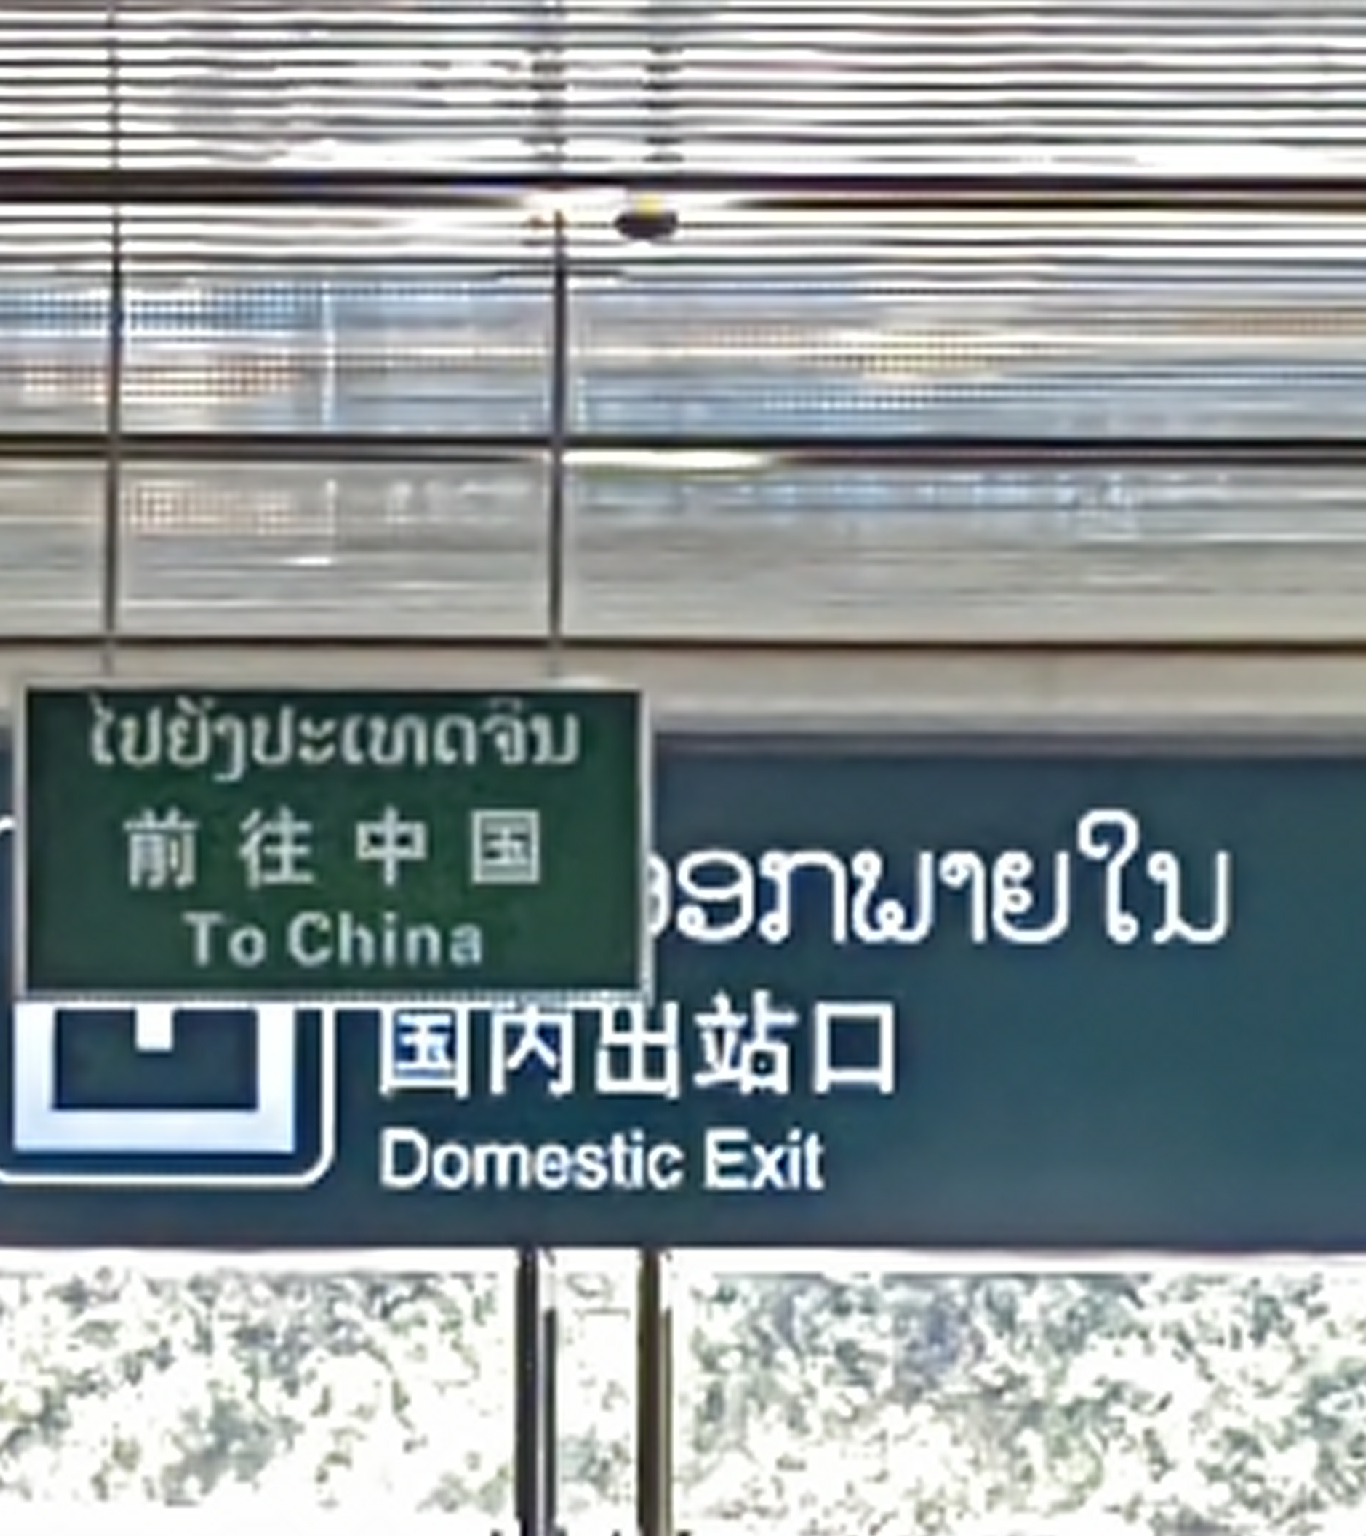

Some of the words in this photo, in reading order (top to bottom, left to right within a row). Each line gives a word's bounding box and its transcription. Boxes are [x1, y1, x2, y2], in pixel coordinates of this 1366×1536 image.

[122, 805, 542, 888] 前往中国
[182, 910, 267, 968] To
[287, 909, 485, 968] China
[378, 992, 896, 1099] 国内出站口
[379, 1126, 685, 1191] Domestic
[703, 1127, 825, 1191] Exit
